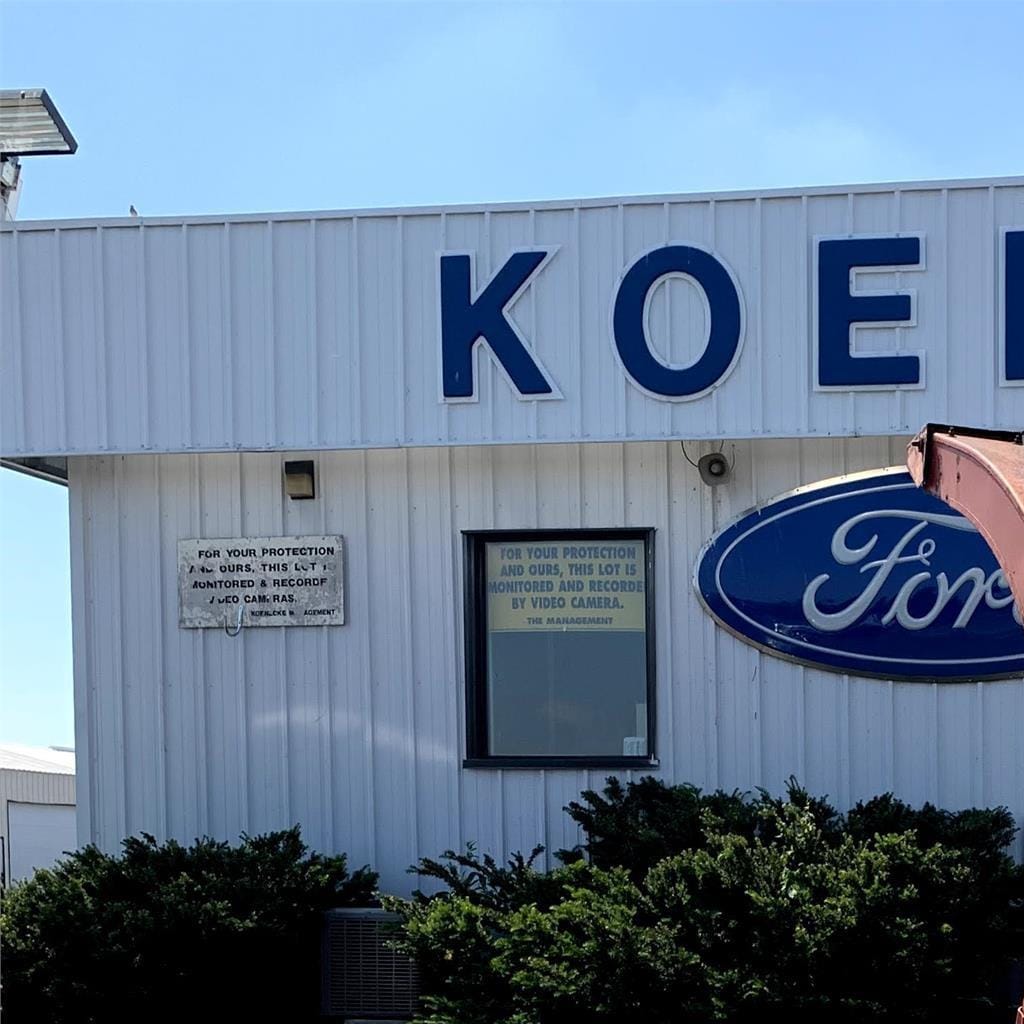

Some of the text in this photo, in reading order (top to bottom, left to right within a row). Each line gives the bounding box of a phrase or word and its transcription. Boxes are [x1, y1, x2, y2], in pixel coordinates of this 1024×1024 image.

[198, 546, 335, 559] FOR YOUR PROTECTION
[501, 546, 636, 560] FOR YOUR PROTECTION
[219, 563, 255, 574] OURS,
[261, 562, 289, 572] THIS
[500, 563, 637, 578] AND OURS, THIS LOT IS
[260, 579, 267, 588] &
[488, 579, 644, 594] MONITORED AND RECORDE
[511, 596, 625, 610] BY VIDEO CAMERA.
[526, 616, 614, 625] THE MANAGEMENT
